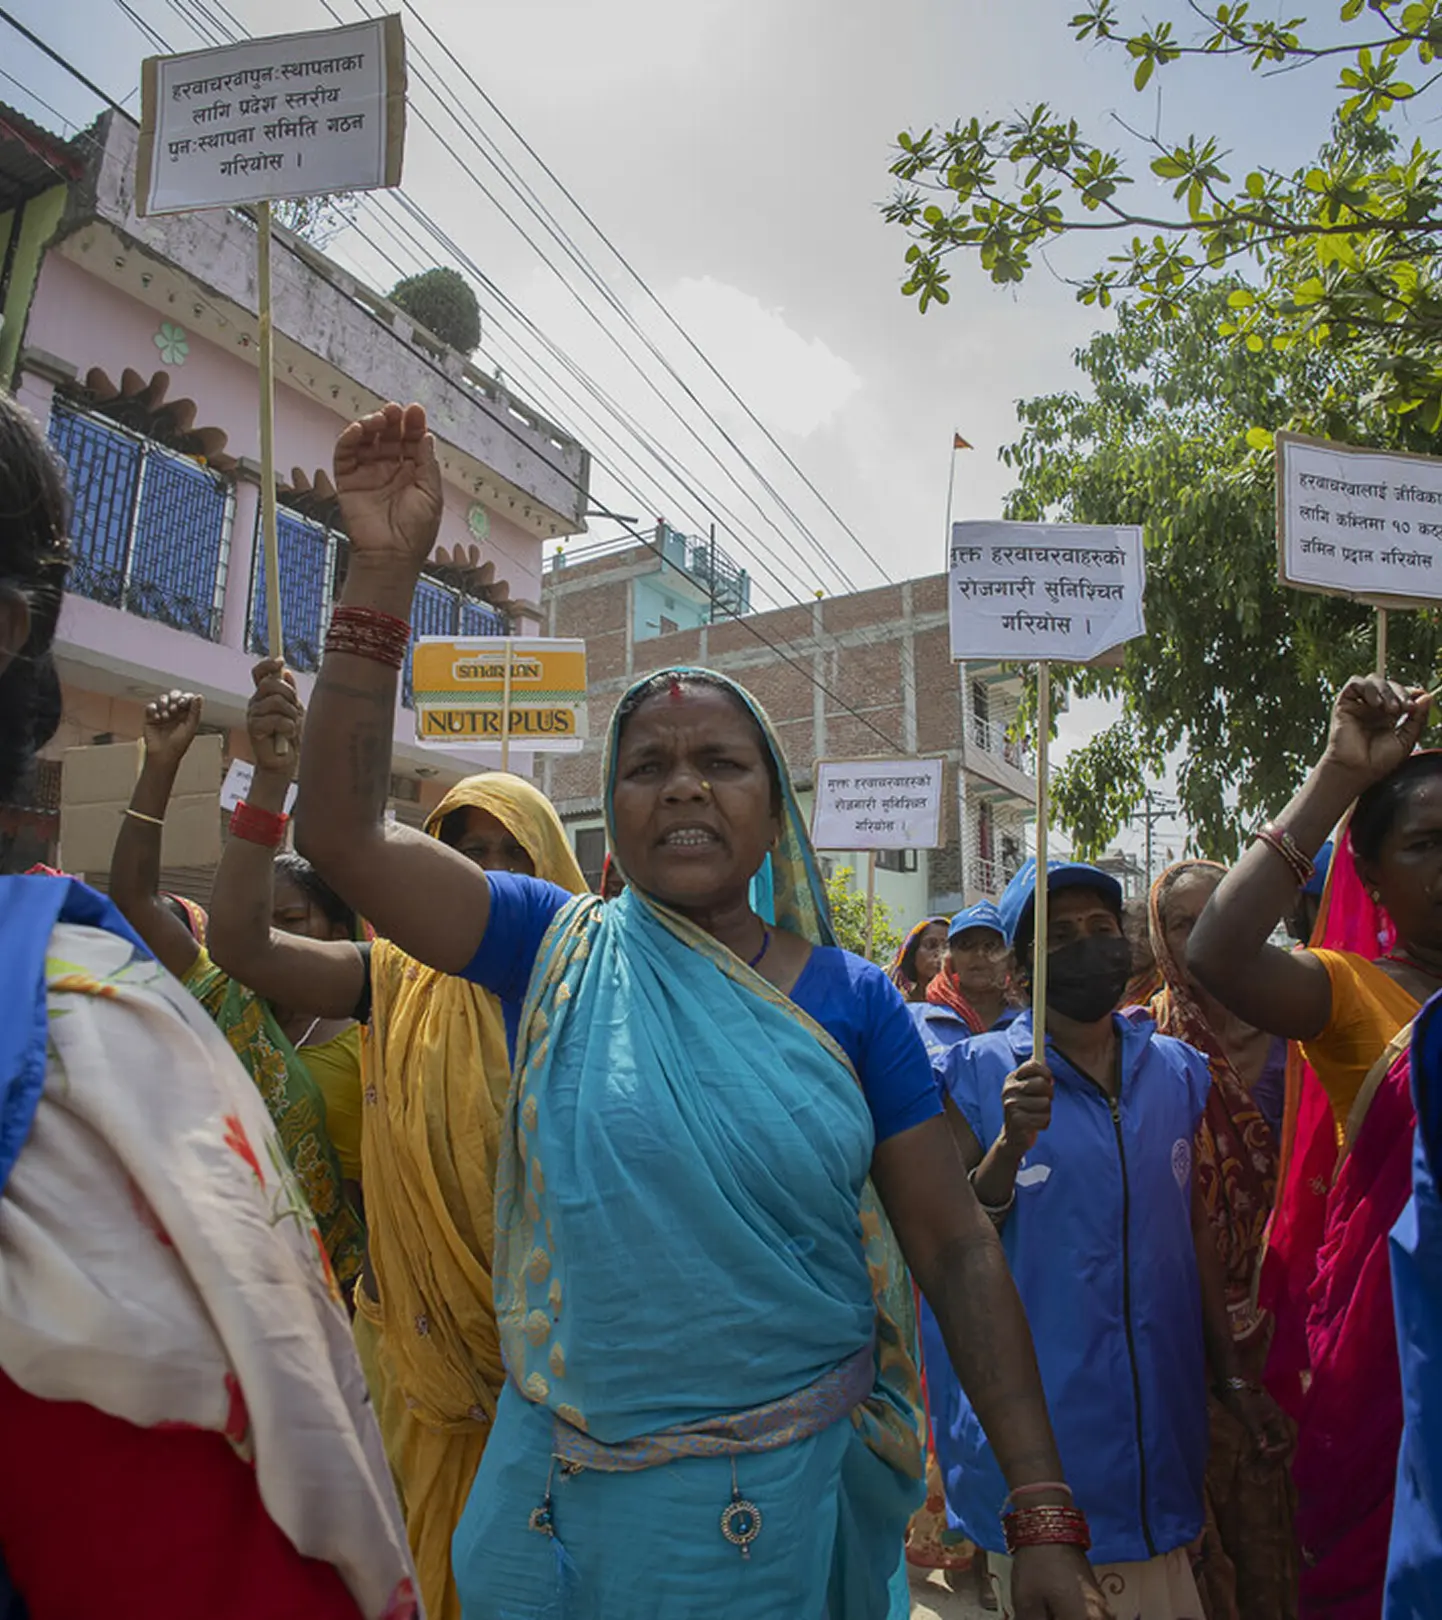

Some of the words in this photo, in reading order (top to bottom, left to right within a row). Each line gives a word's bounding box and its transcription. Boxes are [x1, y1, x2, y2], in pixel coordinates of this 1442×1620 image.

[192, 102, 231, 126] लागि
[239, 95, 276, 115] प्रदेश
[285, 84, 341, 109] स्तरीय
[264, 117, 318, 142] समिति
[327, 114, 365, 133] गठन
[220, 151, 285, 177] गरियोस
[1299, 504, 1330, 524] लागि
[1392, 520, 1411, 534] १०
[1380, 546, 1433, 569] गरियोस
[958, 576, 1036, 600] रोजगारी
[1044, 577, 1125, 603] सुनिश्चित
[1001, 610, 1072, 635] गरियोस
[427, 711, 569, 733] NUTRPLUS
